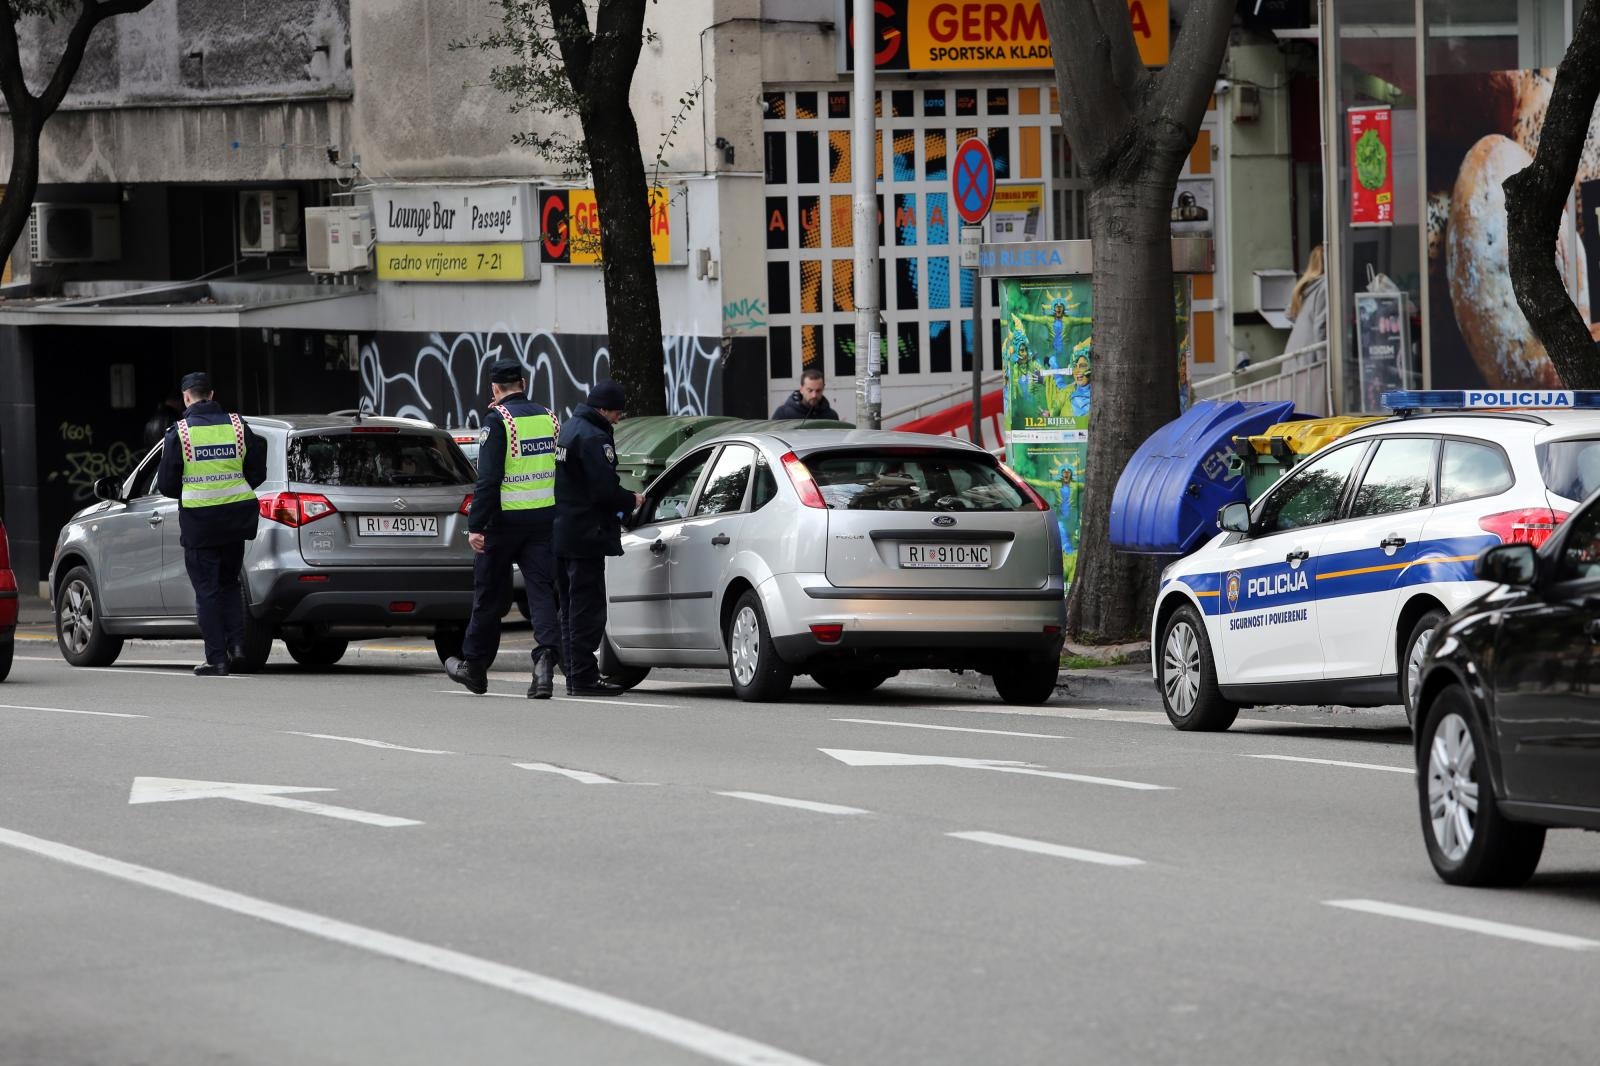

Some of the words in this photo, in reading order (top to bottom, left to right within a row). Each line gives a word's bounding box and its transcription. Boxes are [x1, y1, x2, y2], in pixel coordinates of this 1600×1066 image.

[928, 0, 1152, 42] GERMA
[930, 45, 1006, 61] SPORTSKA
[1010, 44, 1053, 59] KLADI
[924, 98, 945, 108] LOTO
[389, 200, 431, 237] Lounge
[433, 200, 456, 230] Bar
[575, 202, 670, 236] GEIA
[389, 254, 422, 270] radno
[425, 252, 468, 276] vrijeme
[477, 253, 502, 271] 7-21
[1000, 249, 1062, 267] RIJEKA
[1470, 392, 1569, 406] POLICIJA
[1047, 417, 1076, 427] RIJEKA
[196, 447, 235, 458] POLICIJA
[206, 474, 233, 482] POLICIJA
[503, 475, 530, 483] OLICIJA
[367, 518, 381, 531] RI
[391, 518, 436, 532] 490-VZ
[313, 540, 331, 548] HR
[909, 546, 924, 562] RI
[938, 547, 988, 562] 910-NC
[1247, 570, 1309, 599] POLICIJA
[1230, 614, 1264, 631] SIGURNOST
[1269, 608, 1308, 626] POVJERENJE
